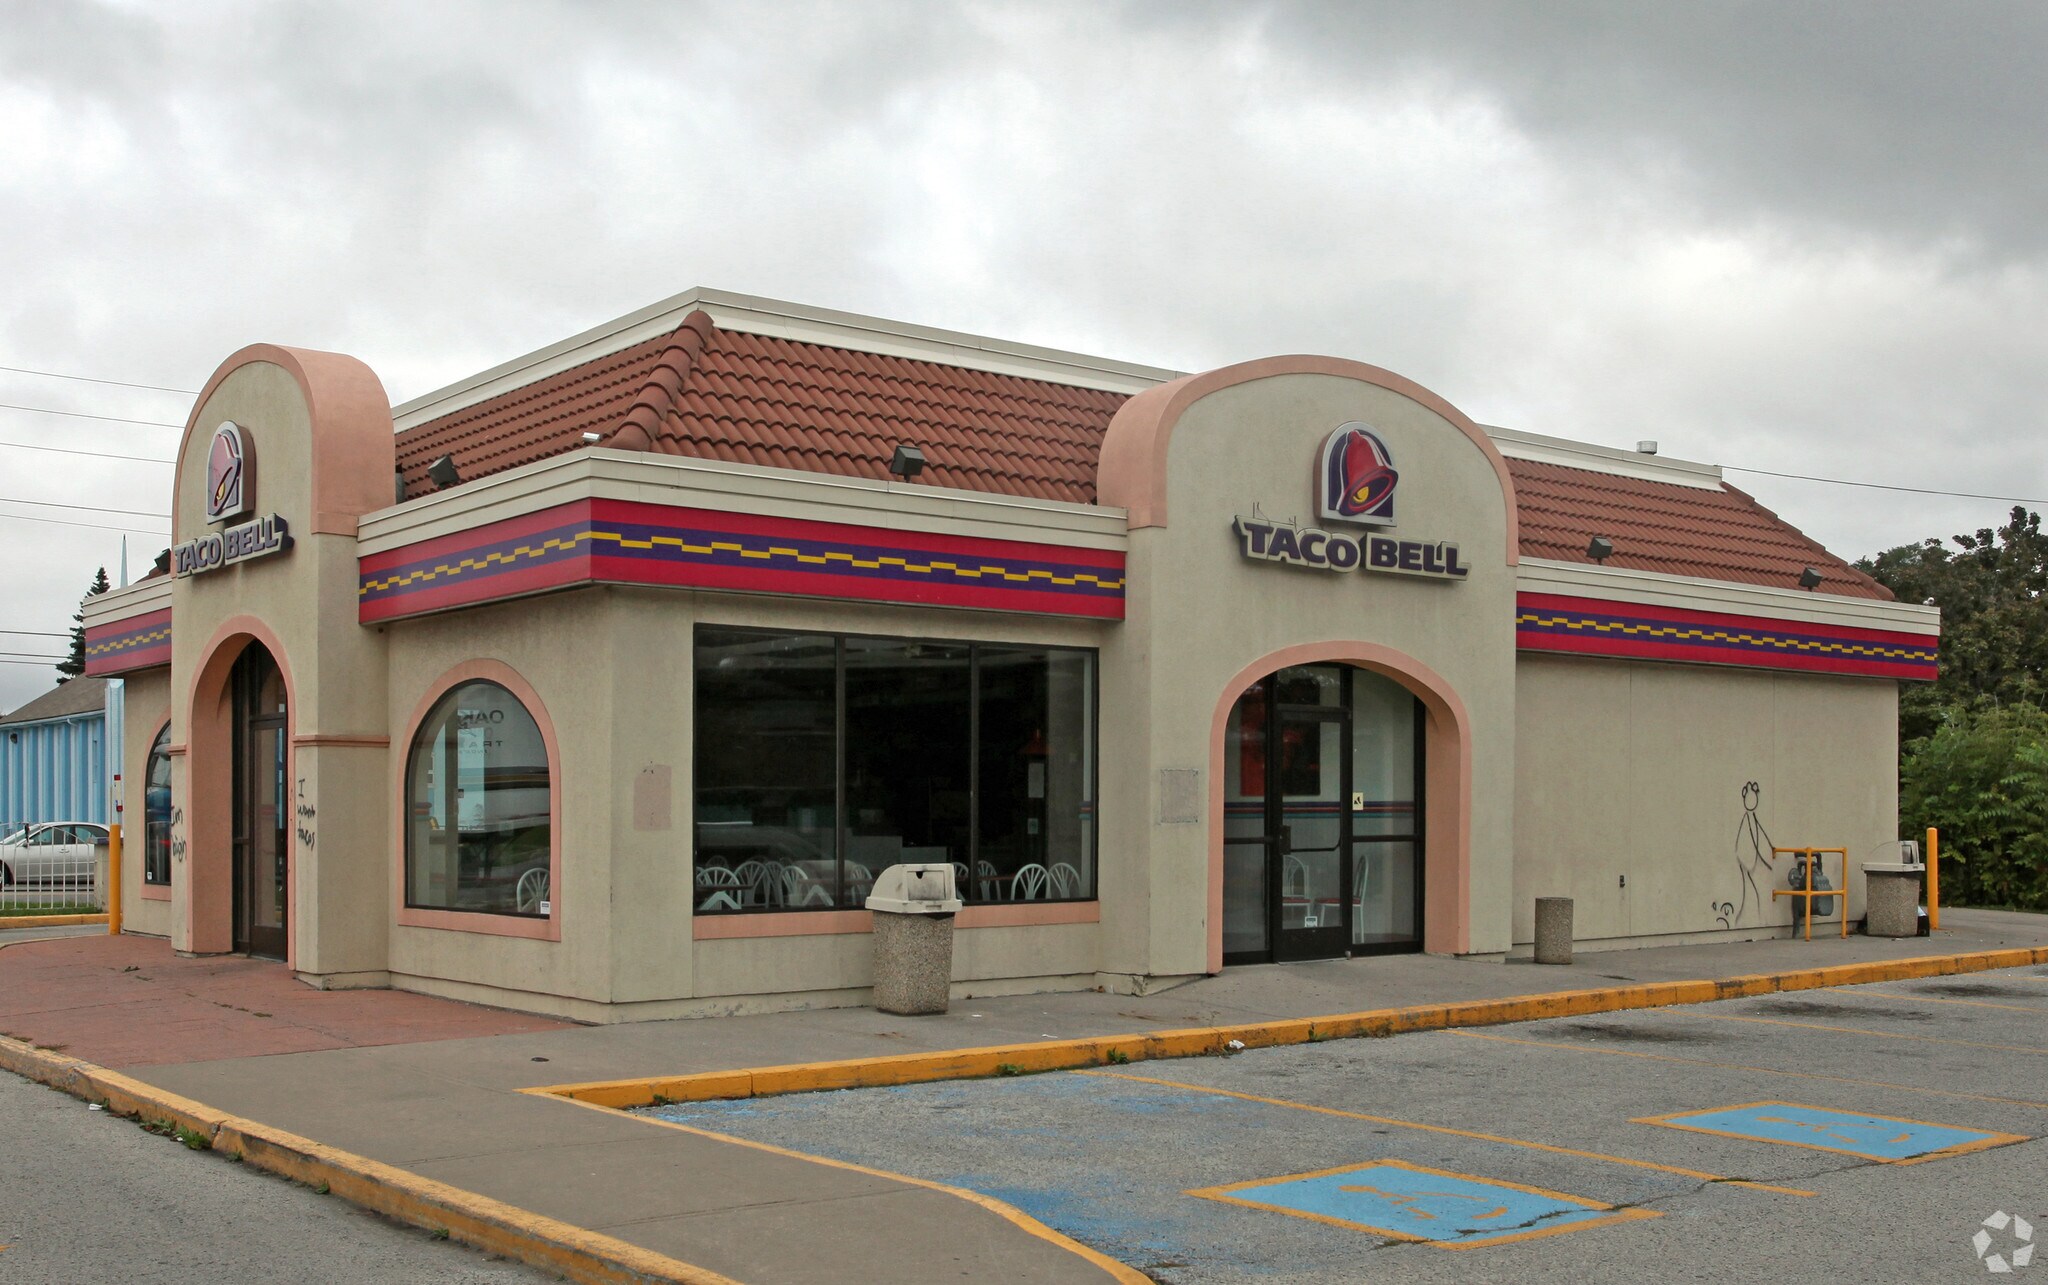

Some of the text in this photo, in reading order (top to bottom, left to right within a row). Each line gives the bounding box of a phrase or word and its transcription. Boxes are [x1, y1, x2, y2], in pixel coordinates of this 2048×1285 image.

[175, 518, 280, 574] TACO BELL
[1243, 521, 1468, 576] TACO BELL
[298, 778, 306, 798] I
